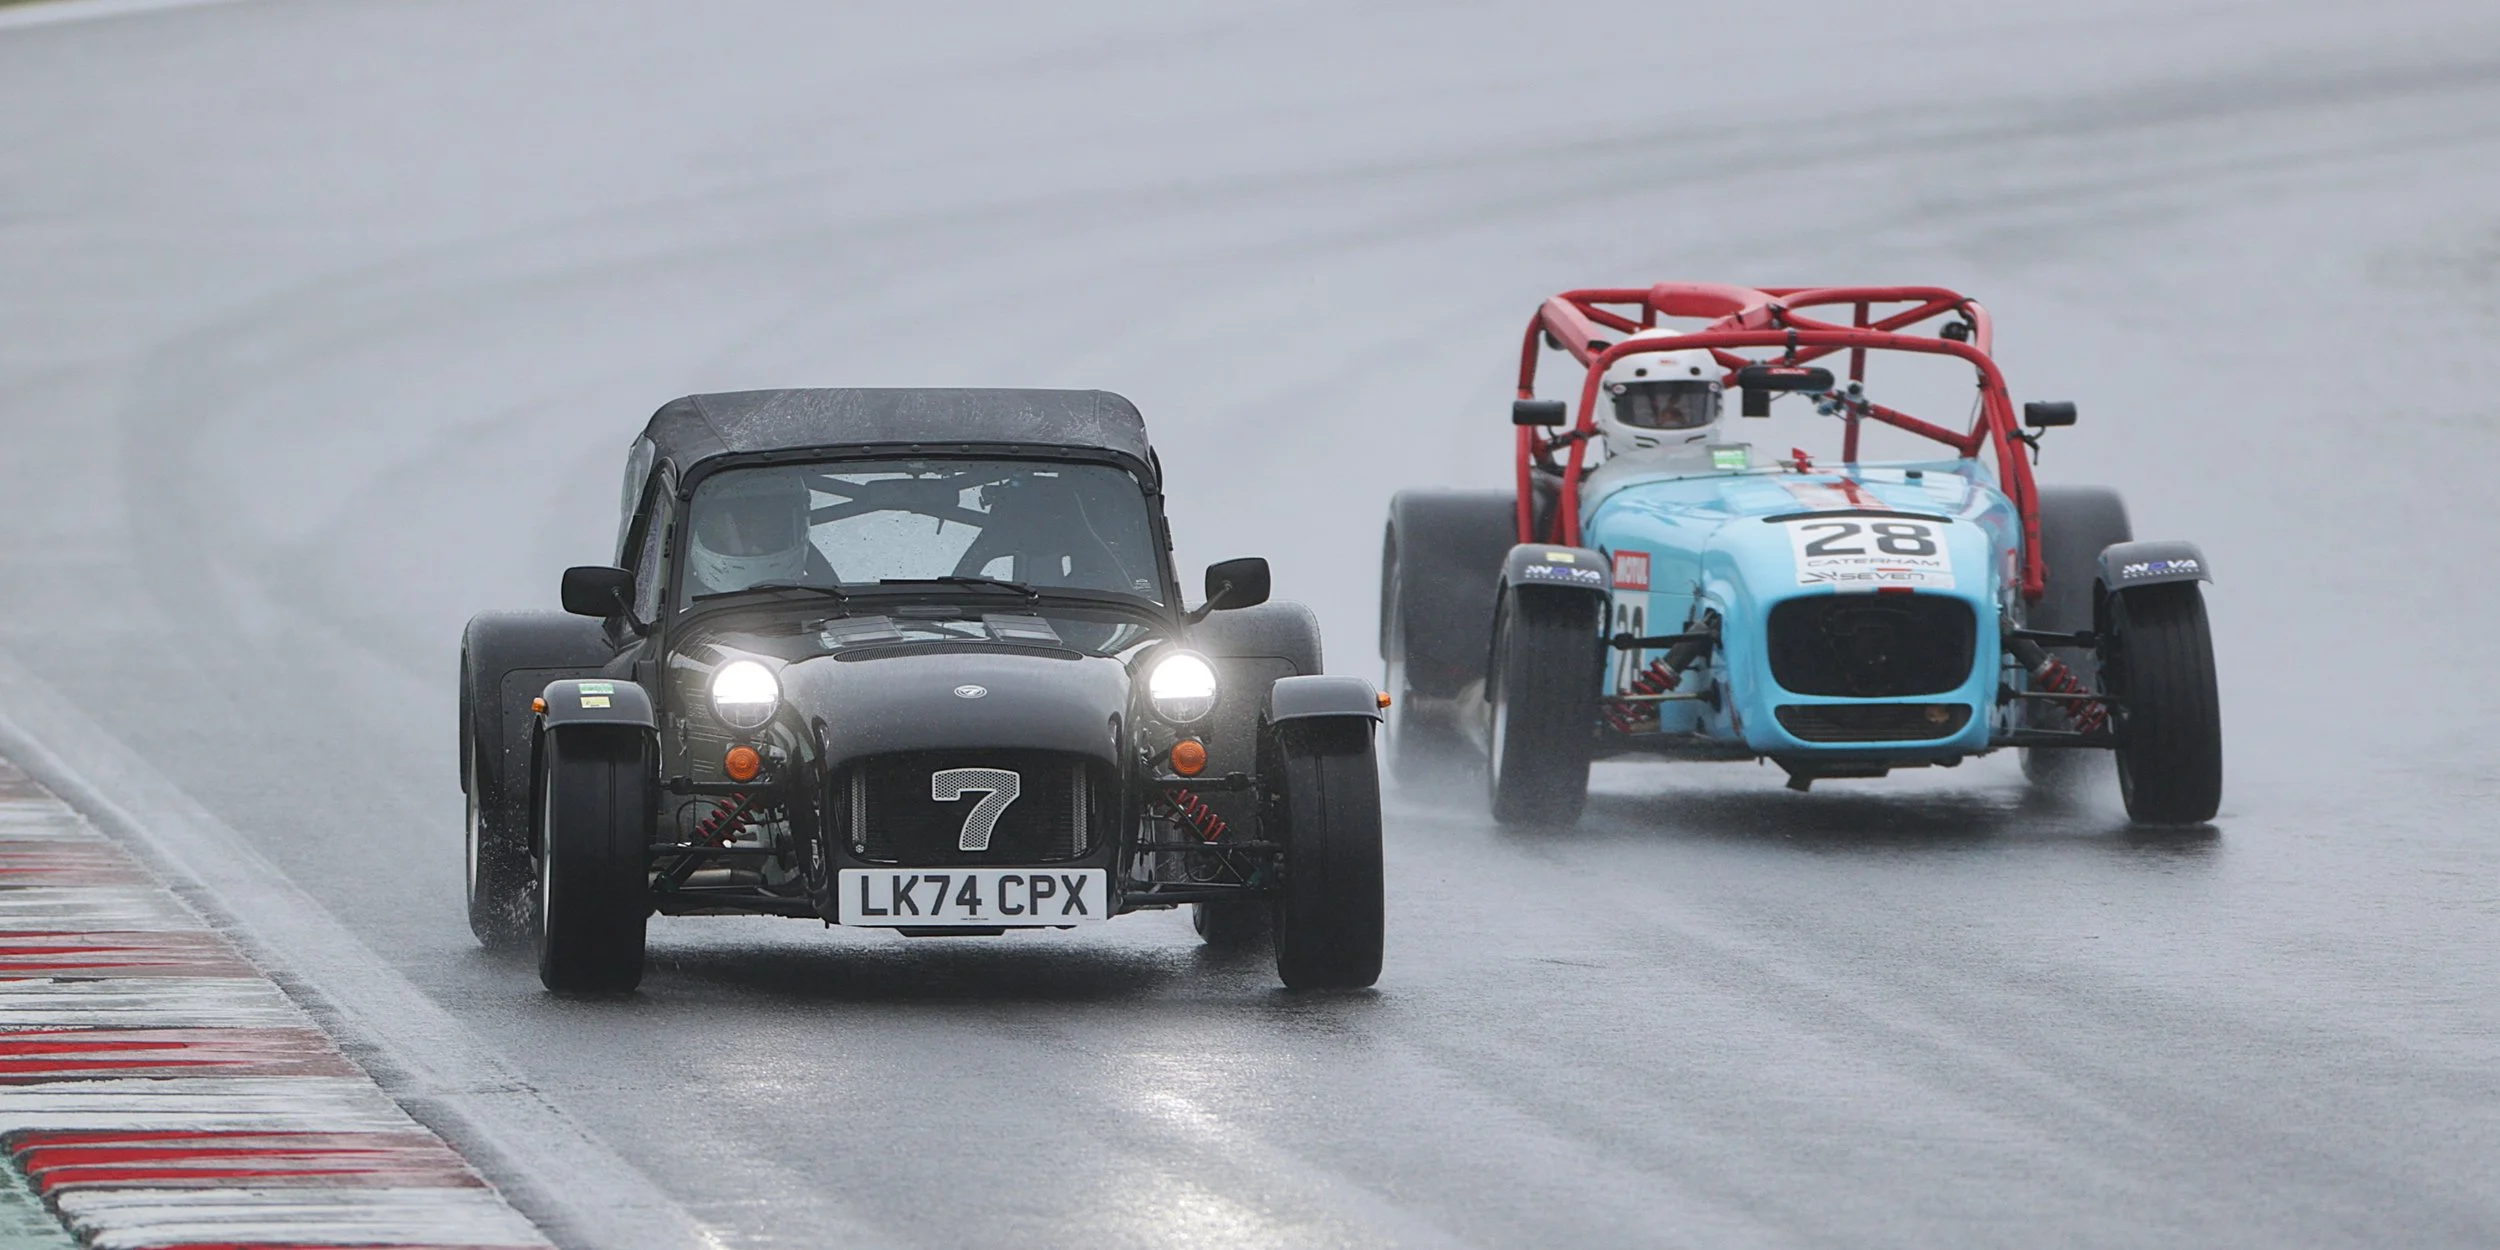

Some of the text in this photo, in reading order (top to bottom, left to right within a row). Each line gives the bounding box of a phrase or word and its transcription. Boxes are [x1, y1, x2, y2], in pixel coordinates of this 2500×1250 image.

[1801, 522, 1937, 558] 28
[1616, 556, 1648, 585] MOTUL
[1807, 558, 1940, 568] CATERHAM
[1839, 572, 1925, 581] SEVEN
[932, 768, 1020, 851] 7
[861, 875, 1088, 916] LK74 CPX
